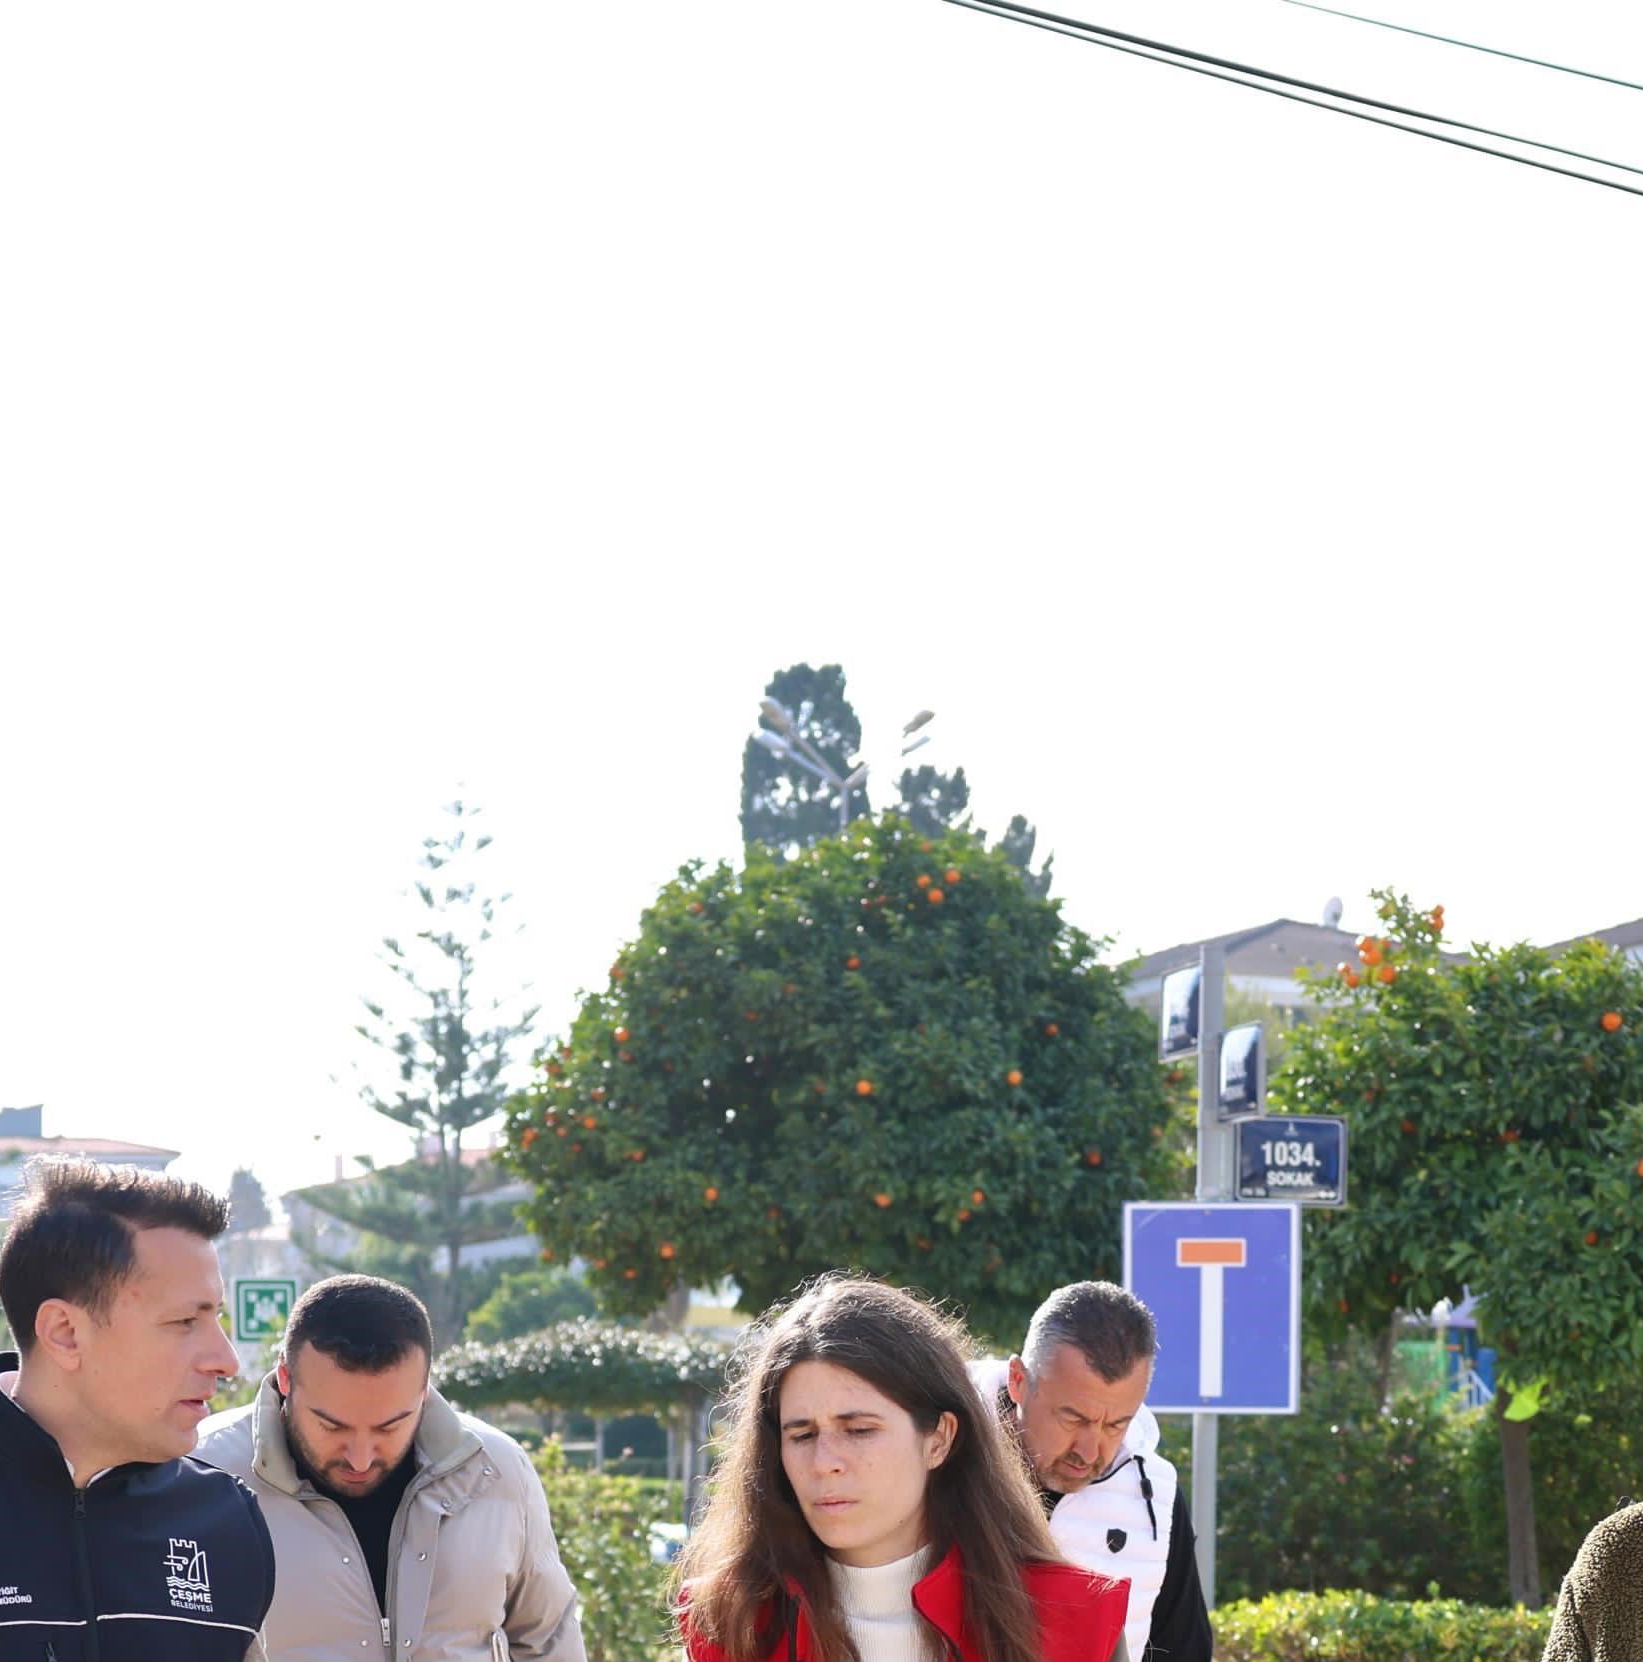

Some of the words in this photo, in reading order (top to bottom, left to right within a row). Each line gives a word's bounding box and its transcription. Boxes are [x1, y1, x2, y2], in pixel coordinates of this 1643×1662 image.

[1261, 1141, 1321, 1167] 1034.
[1266, 1170, 1314, 1186] SOKAK
[169, 1588, 212, 1603] ÇEŞME
[171, 1600, 213, 1612] BELEDİYESİ
